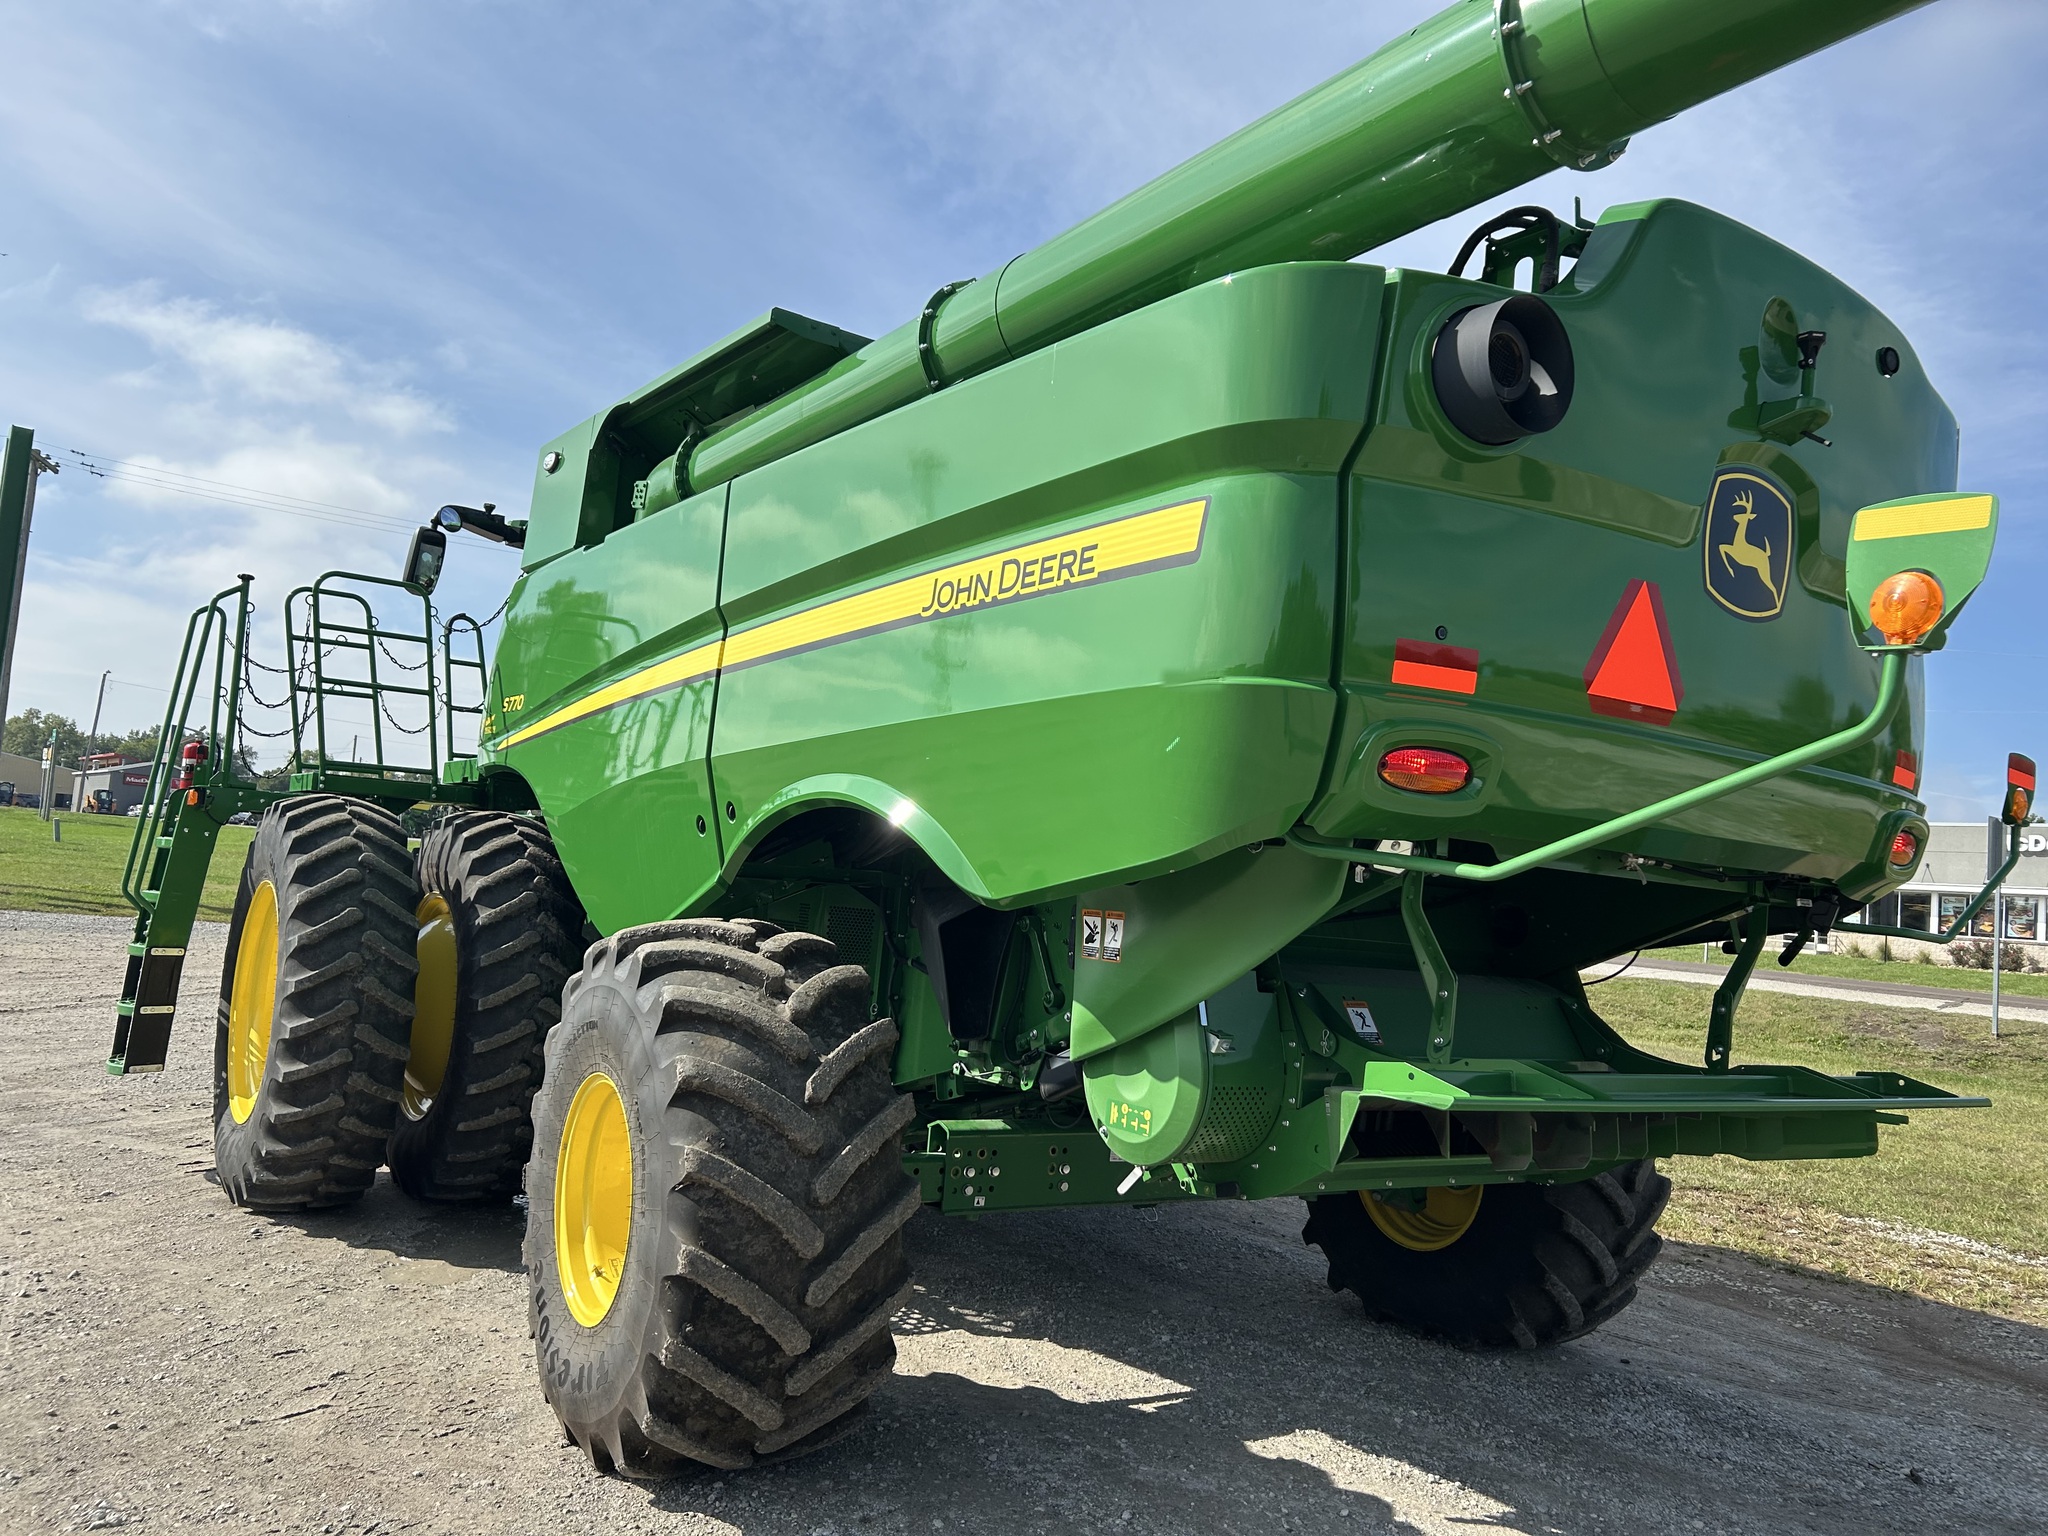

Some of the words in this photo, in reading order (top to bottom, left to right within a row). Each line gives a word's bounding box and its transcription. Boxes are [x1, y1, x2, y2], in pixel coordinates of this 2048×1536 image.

[921, 570, 993, 613] JOHN
[998, 543, 1099, 595] DEERE
[502, 694, 525, 713] S770
